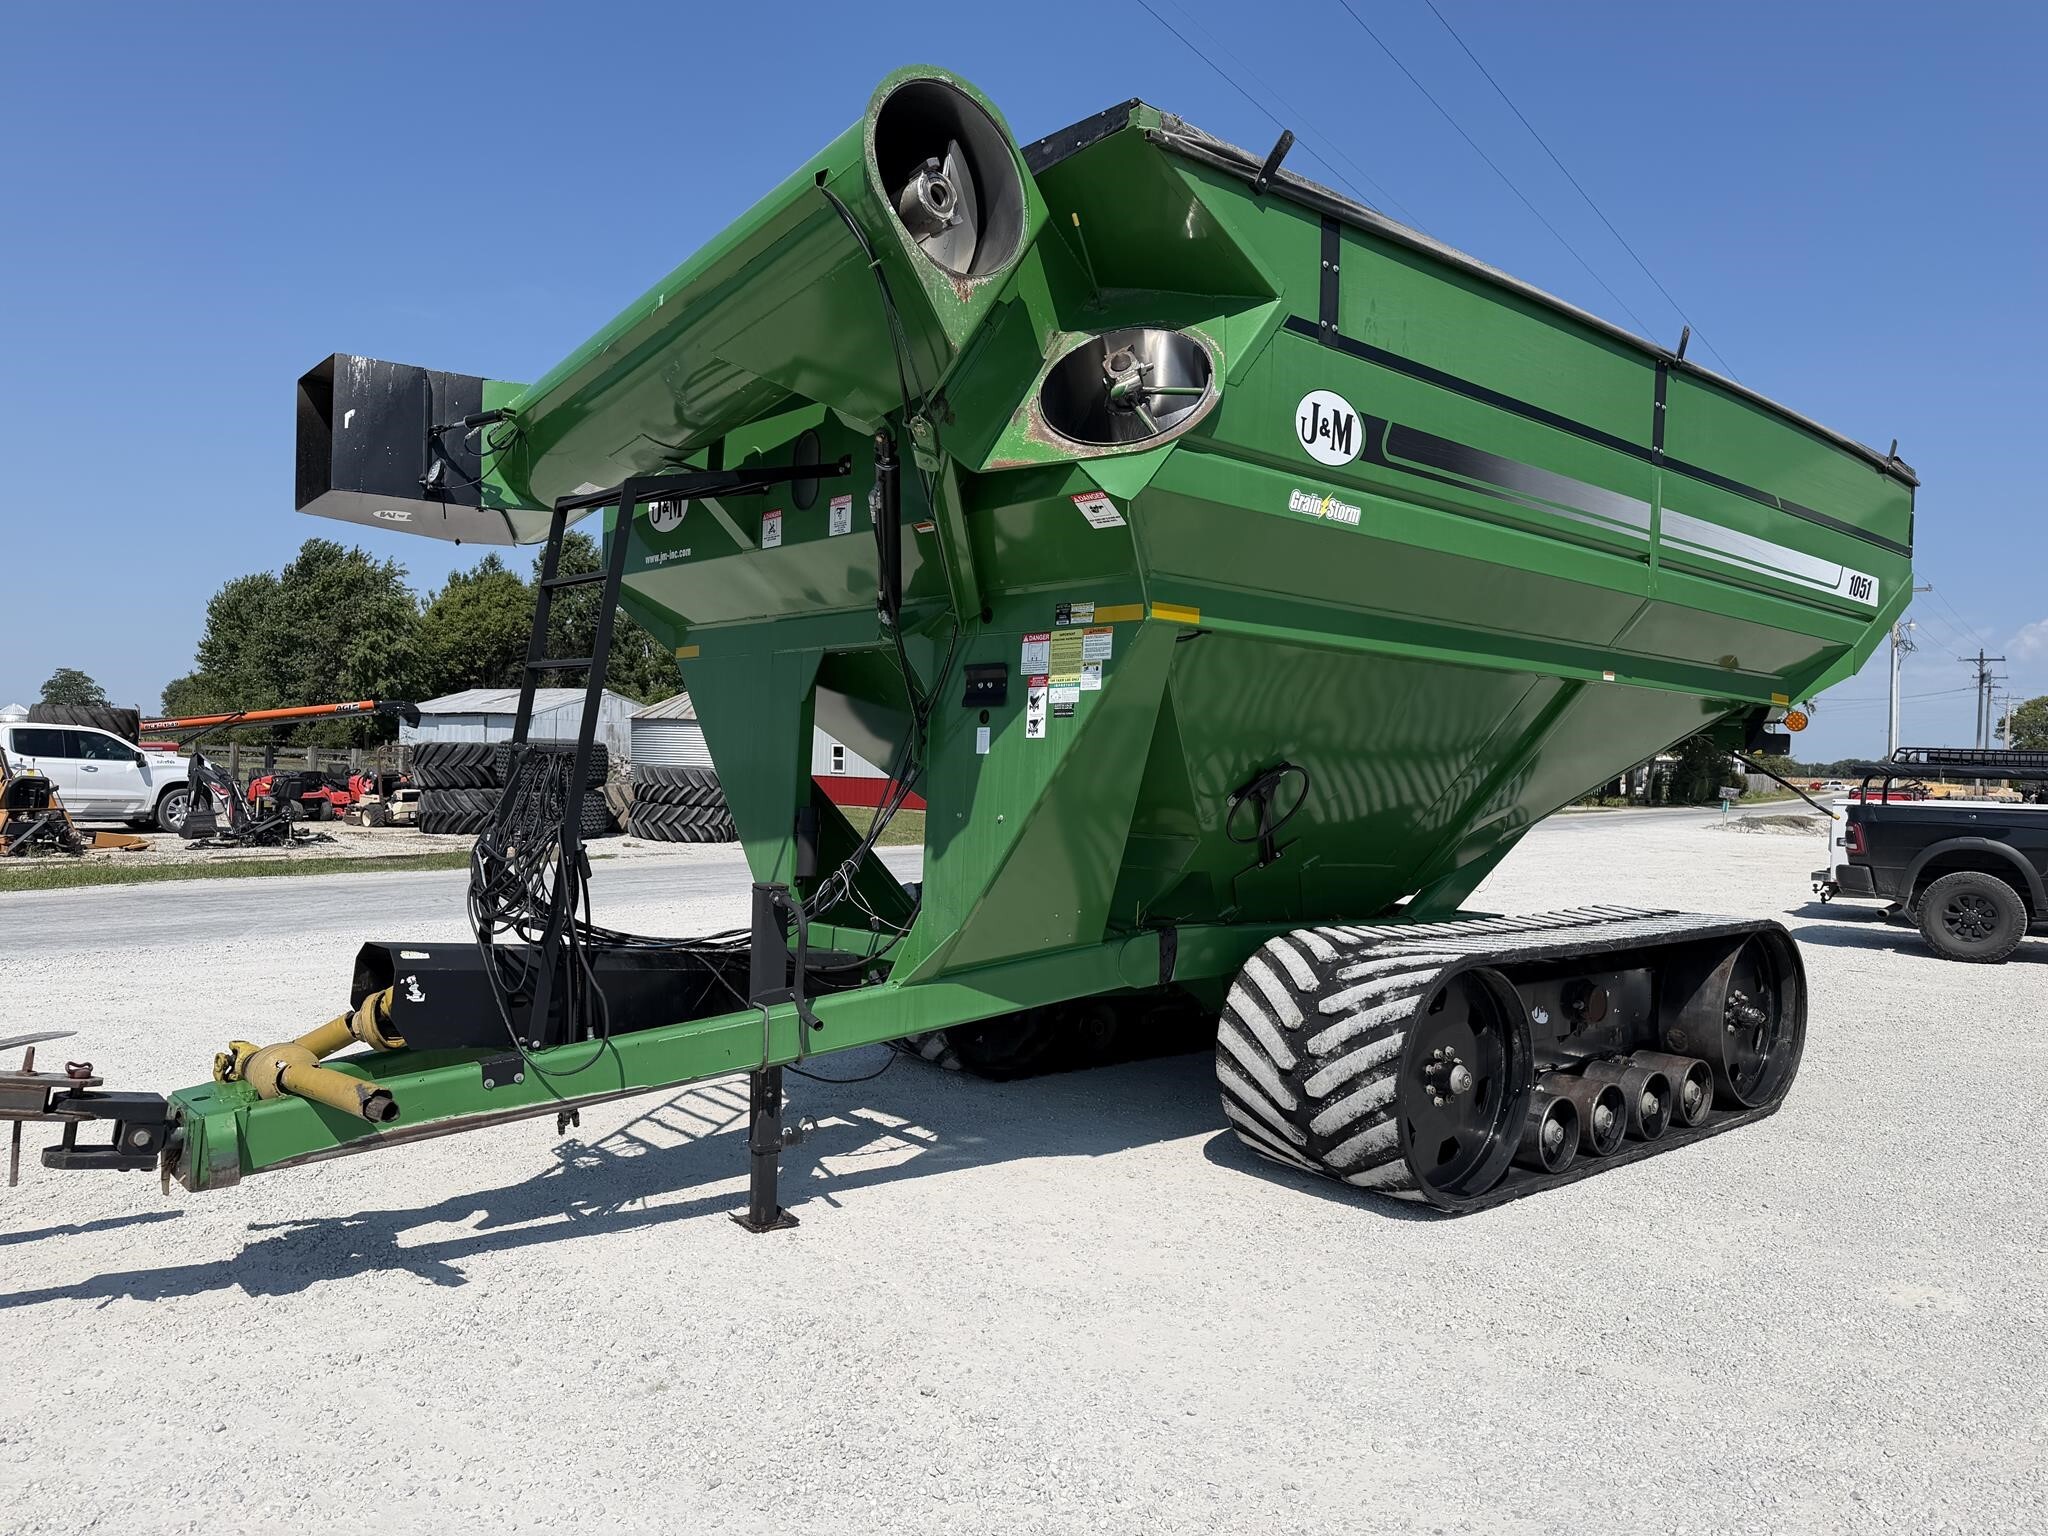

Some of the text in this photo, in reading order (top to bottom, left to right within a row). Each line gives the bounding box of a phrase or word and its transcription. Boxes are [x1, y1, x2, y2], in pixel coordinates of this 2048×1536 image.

[1301, 402, 1354, 455] J&M
[1079, 492, 1106, 501] DANGER
[1289, 489, 1361, 525] Grain Storm
[1849, 574, 1872, 600] 1051
[1028, 633, 1050, 641] DANGER
